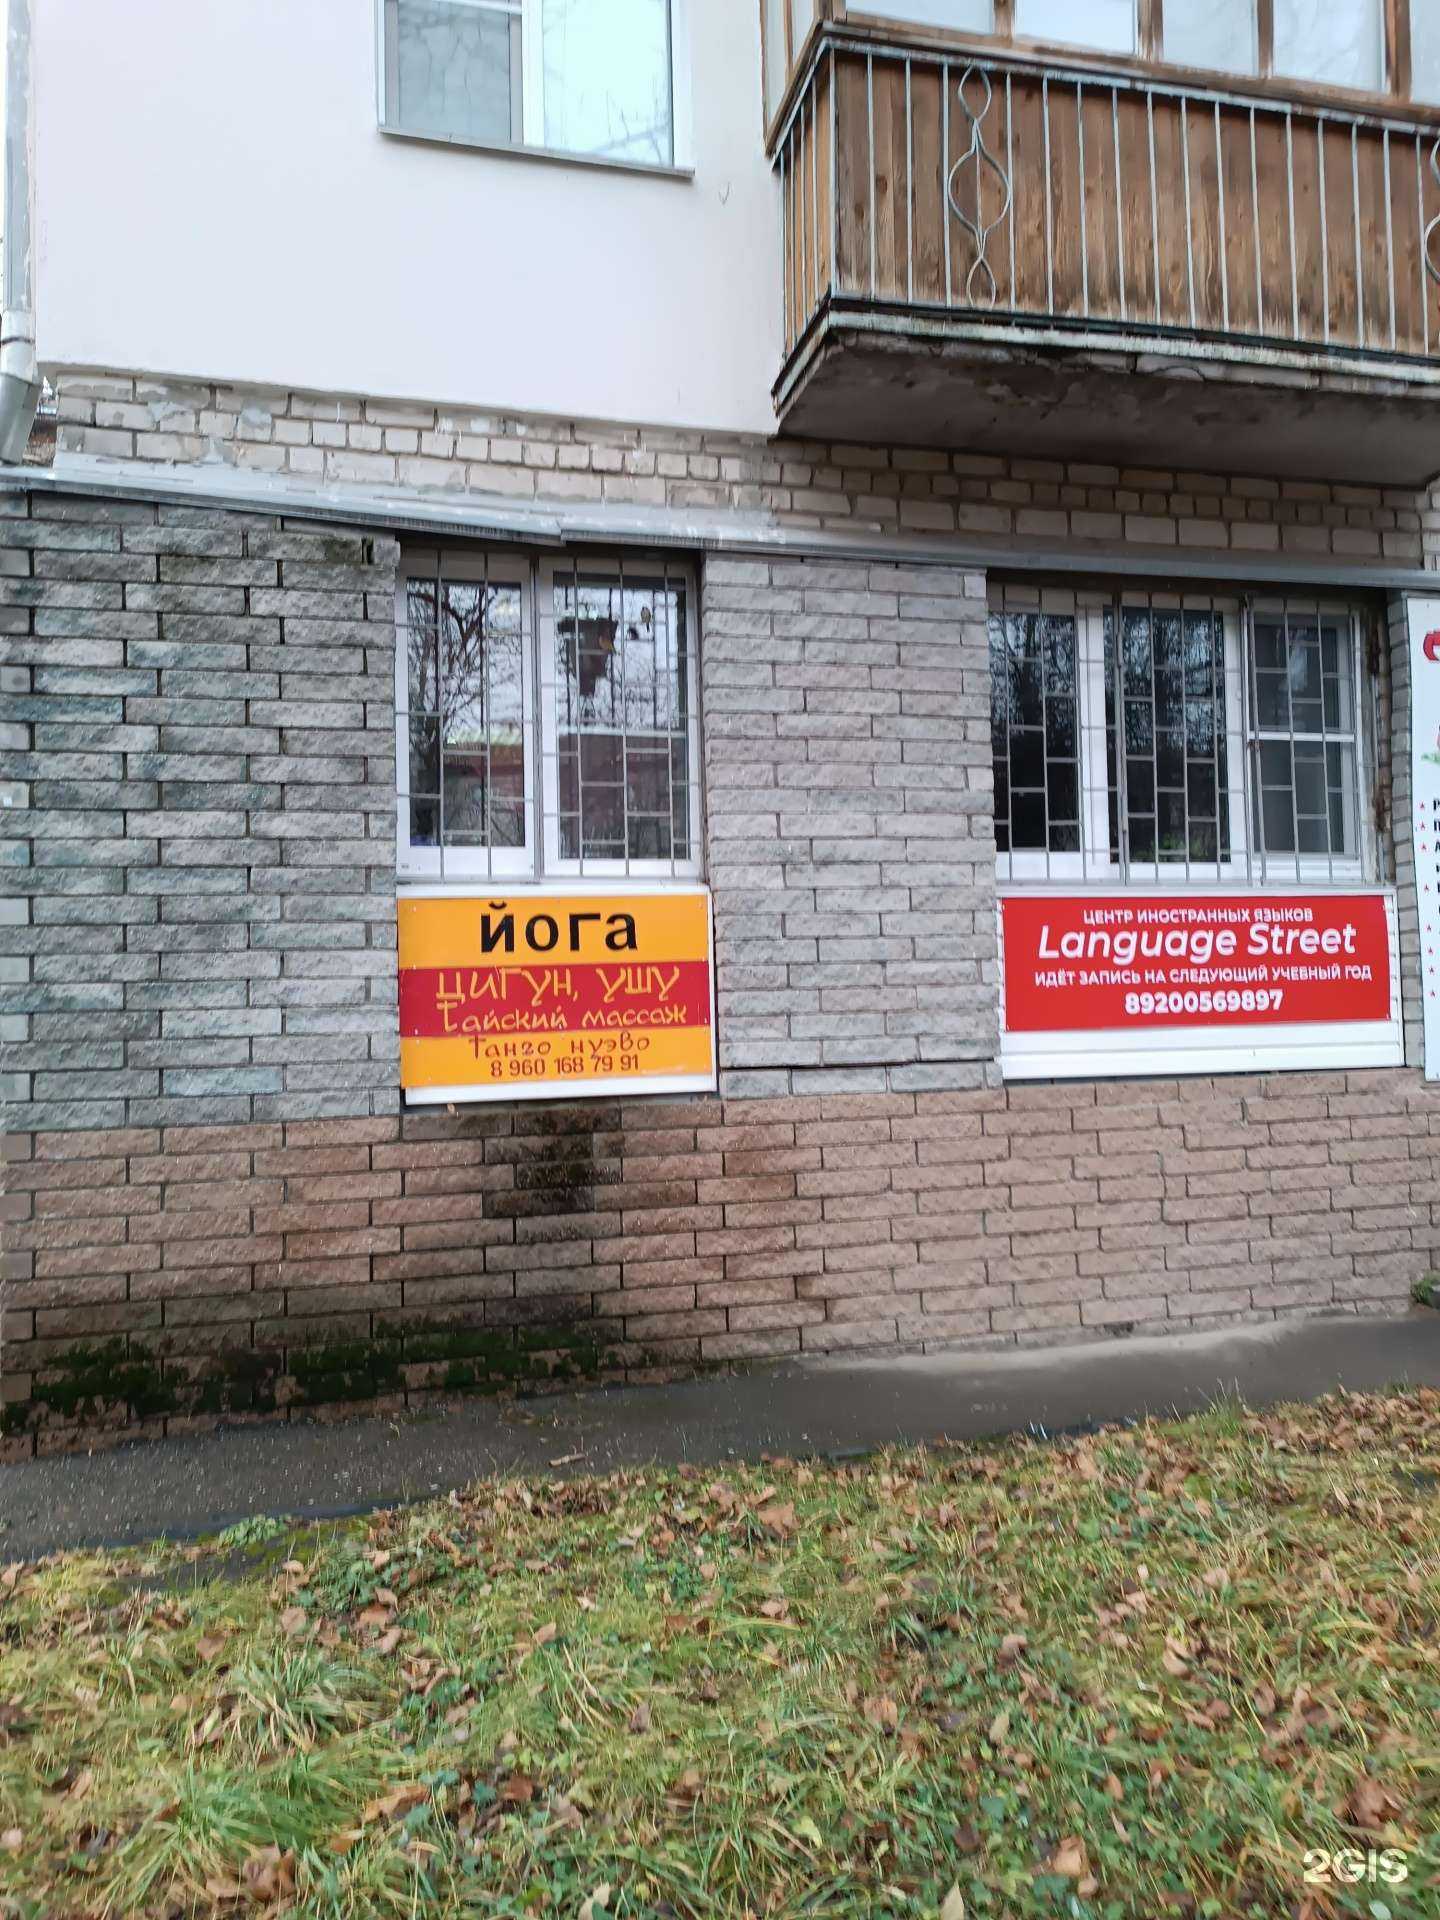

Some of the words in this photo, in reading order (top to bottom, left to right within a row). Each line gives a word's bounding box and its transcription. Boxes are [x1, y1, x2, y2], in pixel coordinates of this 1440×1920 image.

[481, 901, 638, 953] йога
[1083, 909, 1134, 925] ЦЕНТР
[1137, 908, 1250, 924] ИНОСТРАННЫХ
[1254, 907, 1313, 922] ЯЗЫКОВ
[1038, 925, 1238, 965] Language
[1247, 923, 1357, 955] Street
[436, 966, 579, 1007] ЦИГУН,
[596, 966, 680, 1003] УШУ
[1034, 968, 1076, 988] ИДЁТ
[1079, 969, 1141, 986] ЗАПИСЬ
[1144, 969, 1167, 984] НА
[1169, 965, 1269, 985] СЛЕДУЮЩИЙ
[1272, 963, 1342, 982] УЧЕБНЫЙ
[1344, 965, 1373, 982] ГОД
[1124, 988, 1284, 1015] 89200569897
[581, 1004, 687, 1027] массаж
[490, 1060, 503, 1078] 8
[509, 1058, 546, 1077] 960
[553, 1056, 585, 1074] 168
[590, 1055, 613, 1073] 79
[620, 1054, 640, 1071] 91
